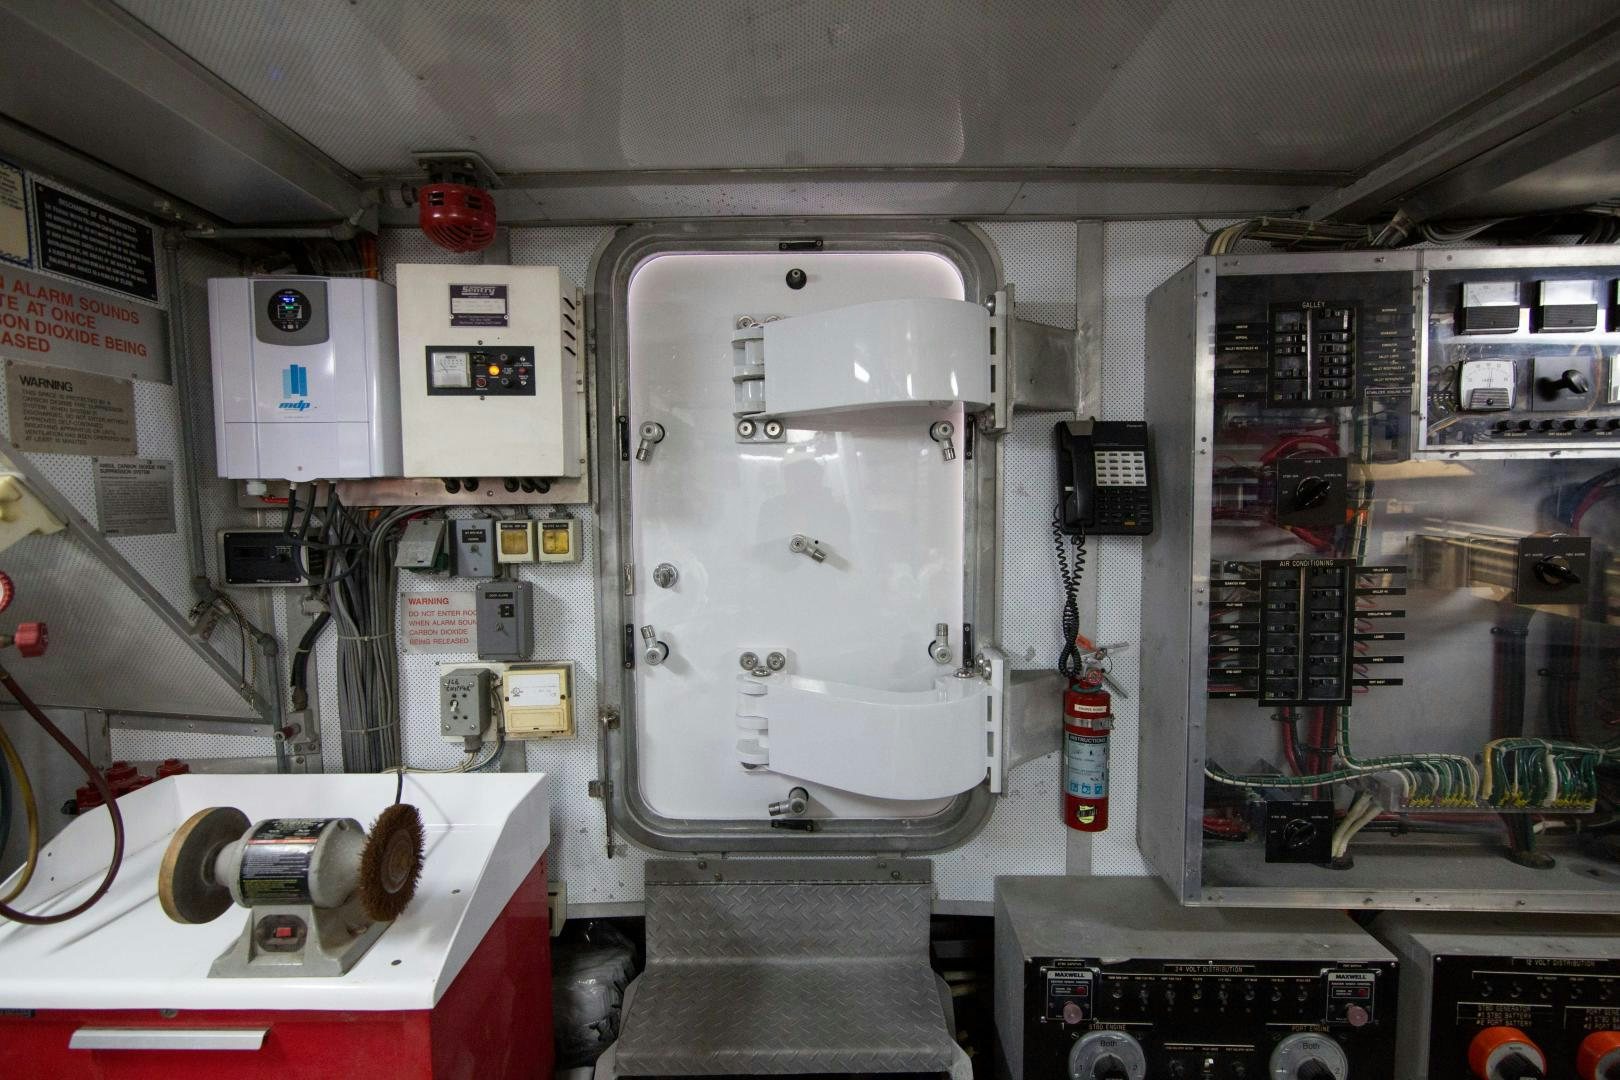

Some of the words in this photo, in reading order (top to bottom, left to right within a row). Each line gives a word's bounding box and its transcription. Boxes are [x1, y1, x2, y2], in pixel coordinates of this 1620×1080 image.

[462, 285, 496, 296] Sentry
[14, 280, 73, 306] ALARM
[80, 297, 139, 324] SOUNDS
[1302, 301, 1325, 309] GALLEY
[27, 302, 46, 317] AT
[52, 307, 97, 329] ONCE
[1, 332, 50, 352] ASED
[35, 320, 100, 346] DIOXIDE
[105, 336, 147, 357] BEING
[19, 375, 73, 392] WARNING
[279, 400, 311, 411] mdp
[1292, 559, 1334, 567] CONDITIONING
[408, 597, 449, 605] WARNING
[1553, 960, 1596, 968] DISTRIBUTION
[1302, 1042, 1320, 1050] Both
